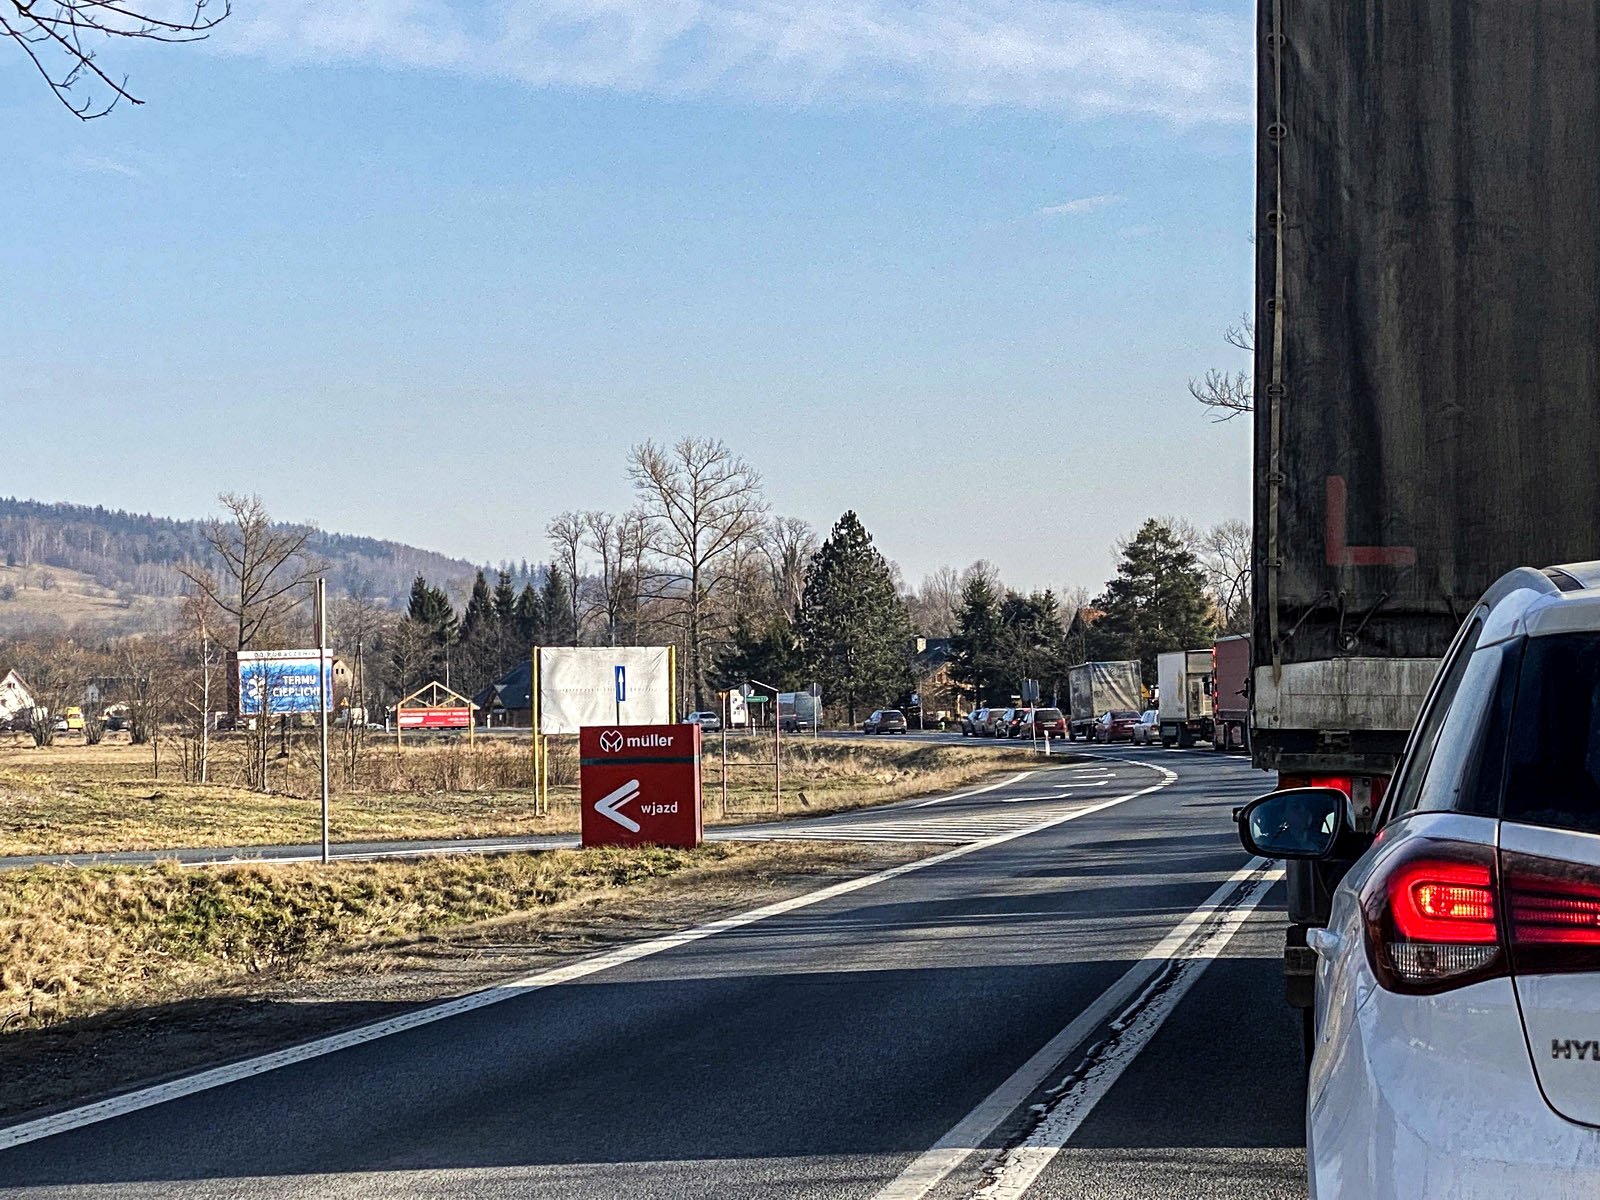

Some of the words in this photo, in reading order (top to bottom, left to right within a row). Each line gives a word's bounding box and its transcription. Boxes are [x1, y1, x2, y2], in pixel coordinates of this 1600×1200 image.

[282, 675, 317, 685] TERMY
[272, 686, 321, 697] CIEPLICKI
[626, 734, 674, 747] müller
[640, 801, 678, 815] wjazd
